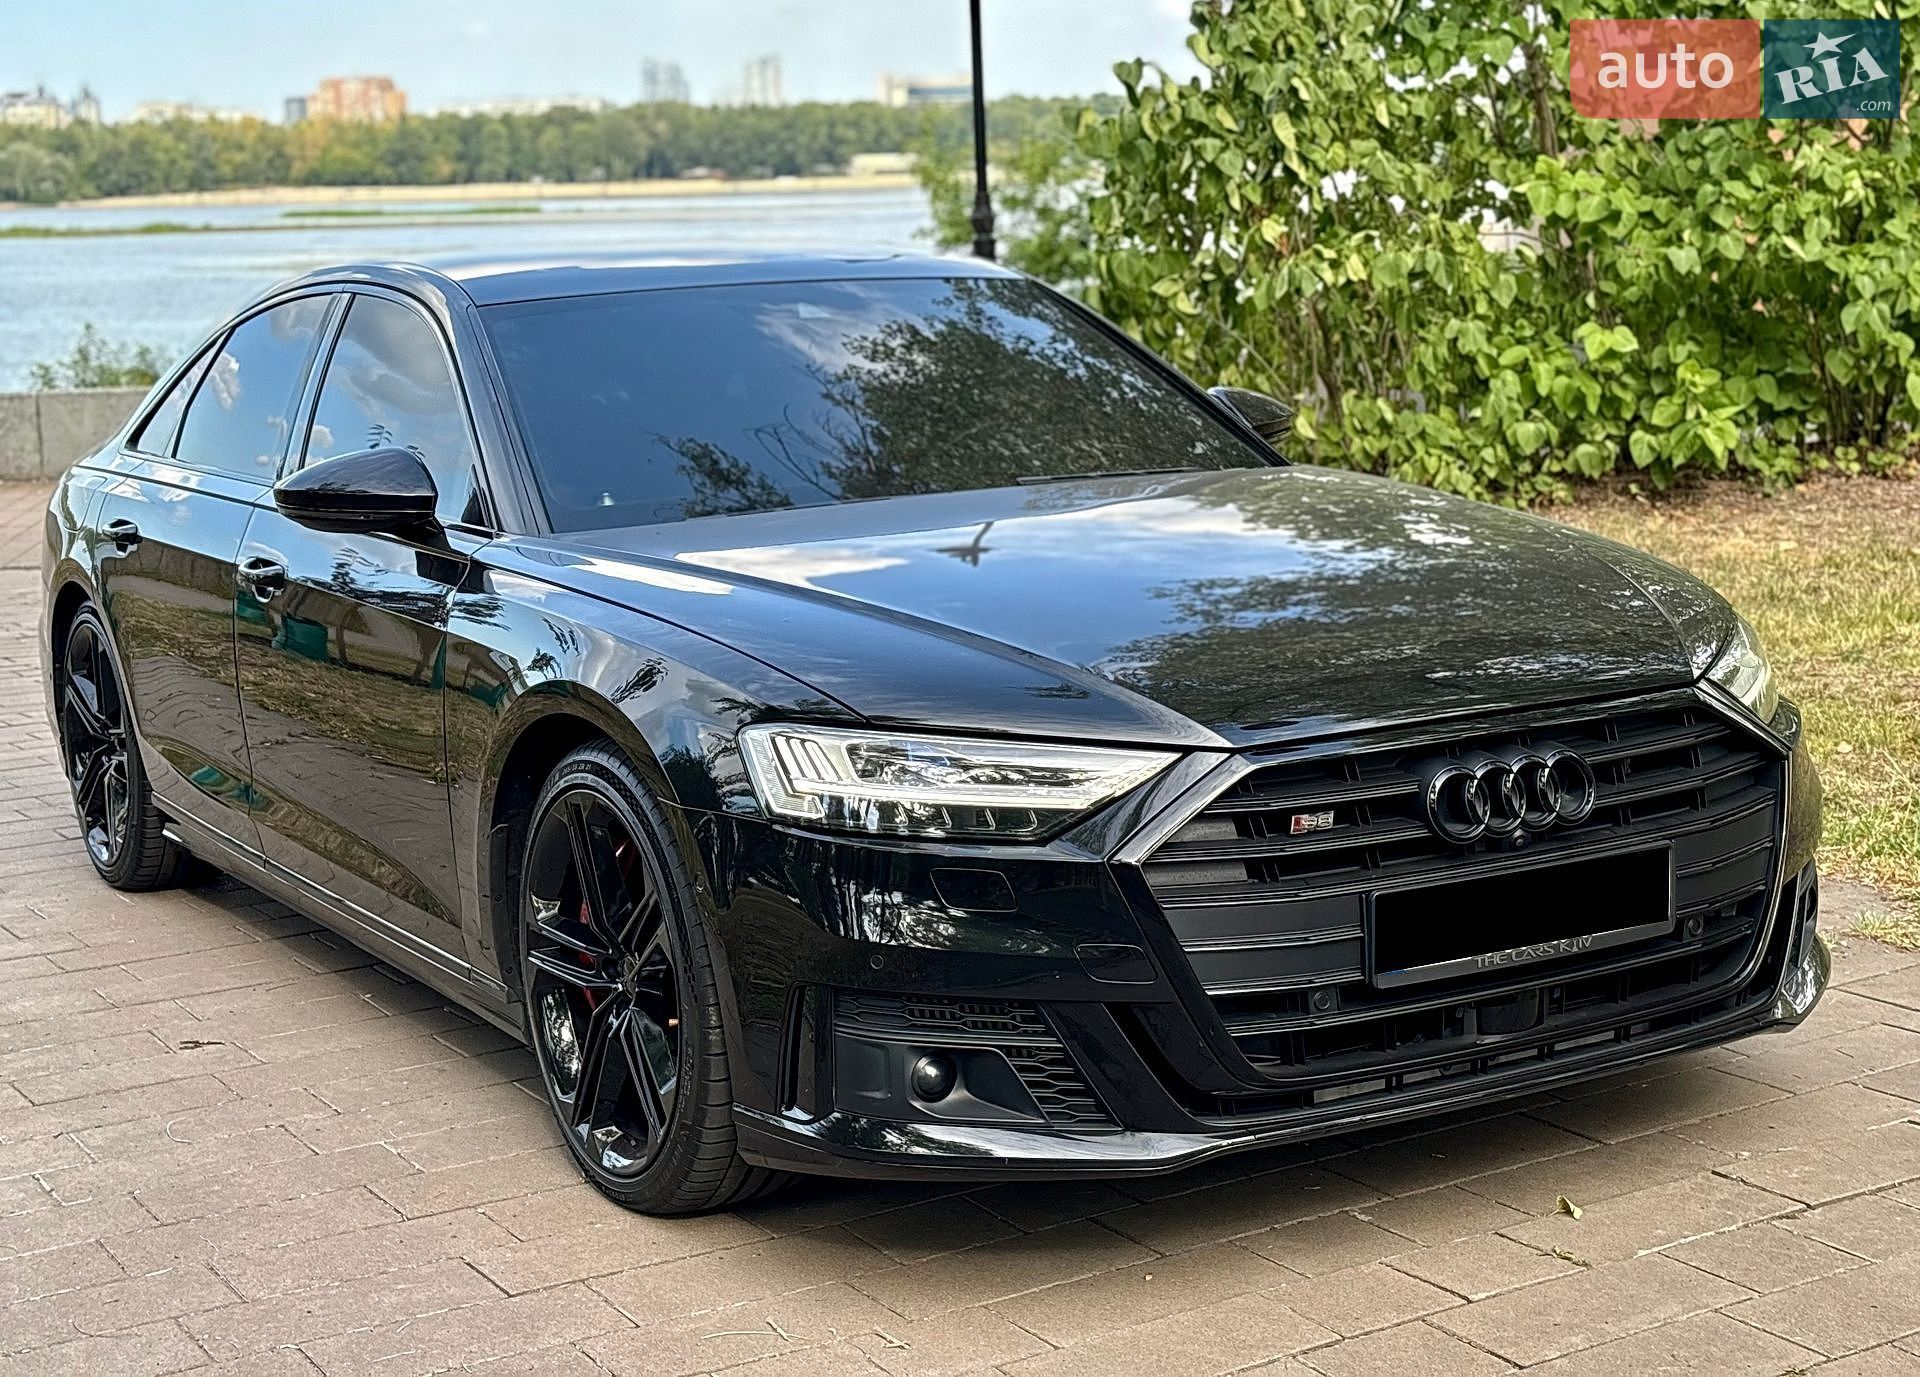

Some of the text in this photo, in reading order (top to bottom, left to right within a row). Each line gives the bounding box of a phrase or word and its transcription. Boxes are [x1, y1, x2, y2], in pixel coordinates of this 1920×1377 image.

[1299, 811, 1334, 833] S8
[1473, 952, 1508, 969] THE
[1511, 944, 1554, 962] CARS
